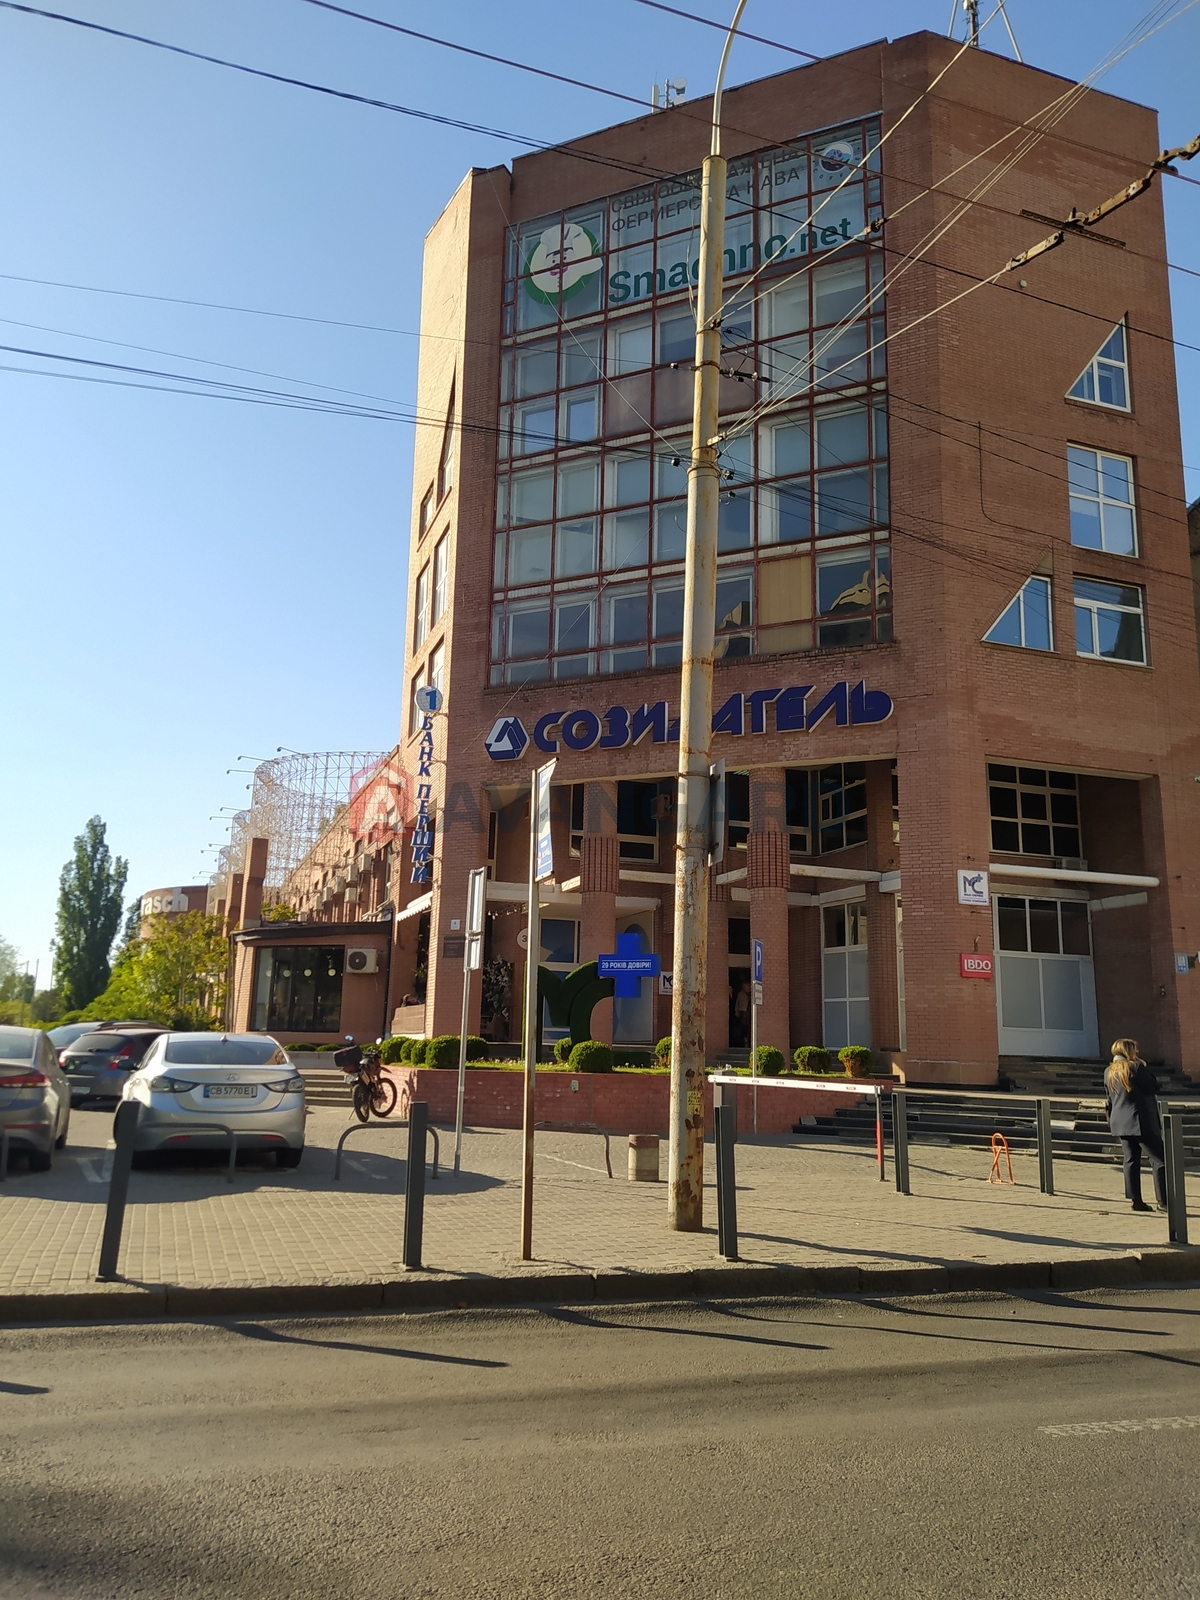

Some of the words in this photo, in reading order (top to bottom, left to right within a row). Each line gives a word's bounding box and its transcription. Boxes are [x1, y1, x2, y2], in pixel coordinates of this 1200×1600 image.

[747, 167, 800, 194] КАВА
[425, 690, 437, 711] 1
[533, 679, 894, 753] СОЗИАТЕЛЬ
[418, 716, 434, 777] БАНК
[410, 784, 434, 883] ПЕРШИЙ
[756, 945, 762, 977] P
[967, 960, 991, 971] BDO
